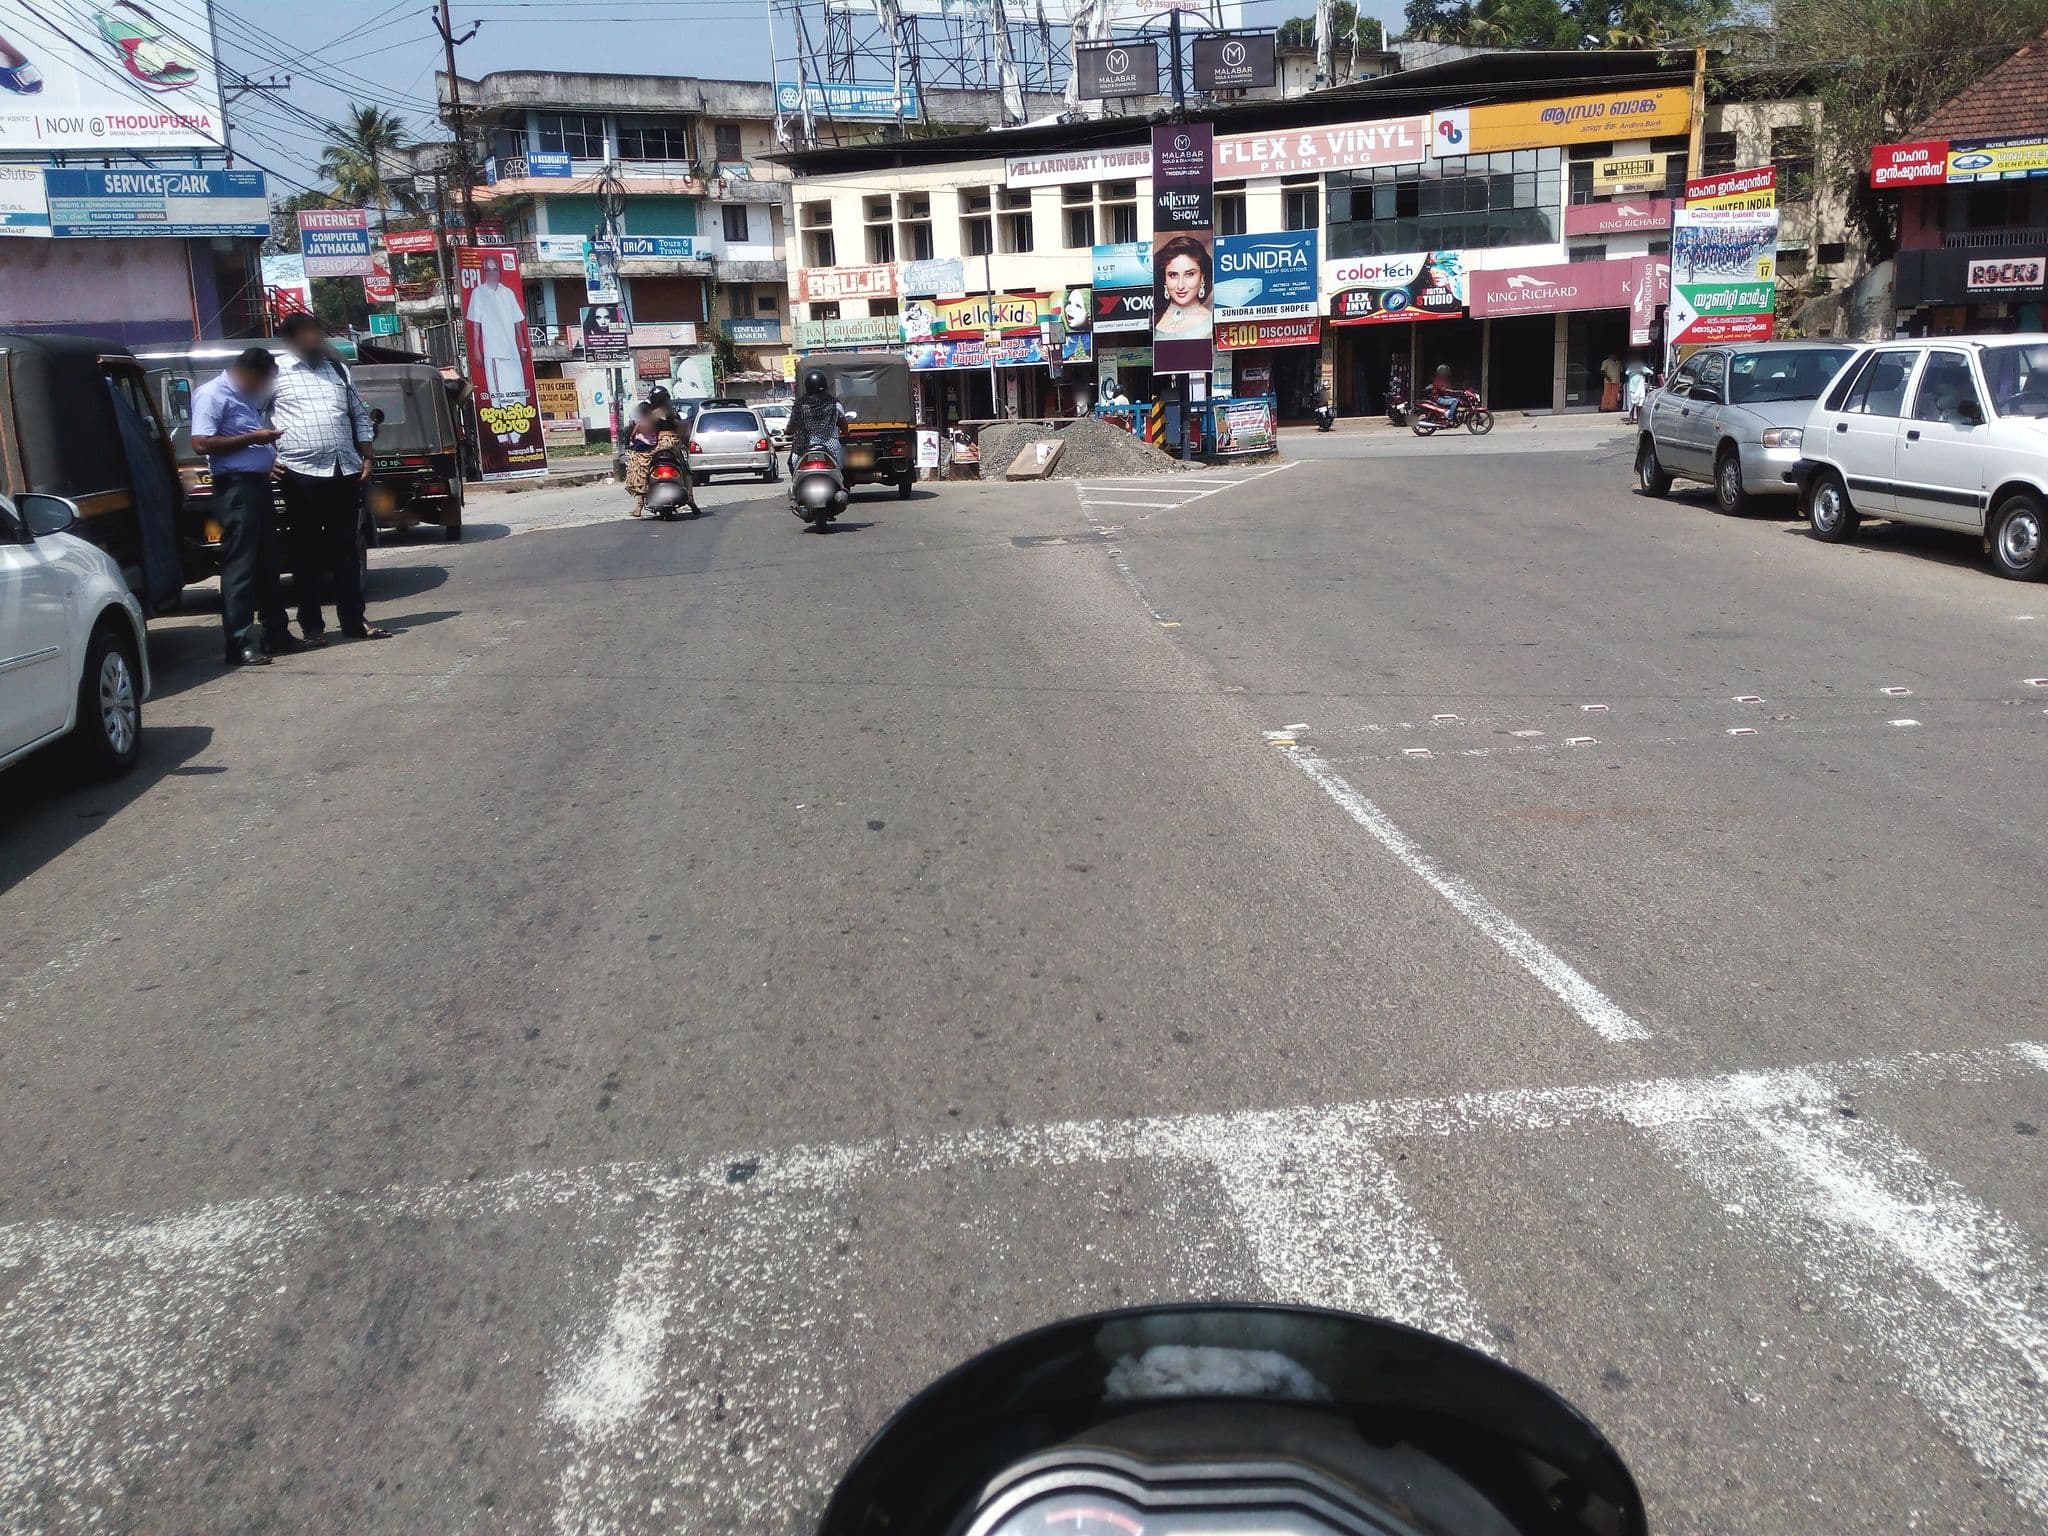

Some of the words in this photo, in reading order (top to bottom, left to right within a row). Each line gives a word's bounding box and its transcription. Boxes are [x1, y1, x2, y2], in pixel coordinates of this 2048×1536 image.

[1214, 66, 1253, 75] MALABAR
[1098, 74, 1137, 84] MALABAR
[831, 89, 850, 104] CLUB
[851, 91, 862, 104] OF
[46, 117, 84, 134] NOW
[90, 117, 105, 136] @
[106, 115, 211, 129] THODUPUZHA
[1219, 136, 1288, 164] FLEX
[1297, 134, 1317, 156] &
[1325, 125, 1414, 153] VINYL
[2007, 138, 2042, 146] INSURANCE
[1162, 151, 1203, 159] MALABAR
[1892, 149, 1928, 163] വാഹന
[1010, 157, 1097, 177] VELLARINGATT
[1101, 151, 1150, 167] TOWERS
[1260, 152, 1372, 172] PRINTING
[1604, 160, 1644, 171] WESTERN
[1998, 158, 2043, 168] GENERAL
[1688, 184, 1716, 198] വാഹന
[1157, 191, 1200, 210] ARTISTRY
[1747, 197, 1771, 210] INDIA
[304, 213, 361, 226] INTERNET
[1172, 210, 1200, 220] SHOW
[1600, 220, 1622, 229] KING
[1625, 217, 1666, 228] RICHARD
[312, 232, 358, 242] COMPUTER
[658, 239, 681, 247] Tours
[308, 243, 366, 254] JATHAKAM
[623, 240, 654, 253] ORION
[659, 247, 688, 255] Travels
[311, 259, 367, 272] PANCARD
[1221, 249, 1308, 272] SUNIDRA
[1336, 261, 1414, 282] colortech
[1760, 265, 1770, 277] 17
[1972, 263, 2039, 285] ROCKS
[461, 269, 482, 289] CPI
[1643, 263, 1653, 301] RICHARD
[1341, 291, 1370, 303] FLEX
[1416, 293, 1454, 306] STUDIO
[1487, 291, 1518, 303] KING
[1522, 286, 1578, 300] RICHARD
[1222, 309, 1254, 317] SUNIDRA
[1256, 306, 1277, 315] HOME
[1280, 304, 1310, 313] SHOPEE
[1337, 301, 1373, 312] VINYL
[949, 307, 993, 330] Hello
[999, 302, 1033, 325] Kids
[1228, 325, 1258, 346] 500
[1259, 323, 1314, 339] DISCOUNT
[957, 341, 986, 355] Merry
[952, 351, 984, 364] Happy
[1007, 349, 1030, 360] Year
